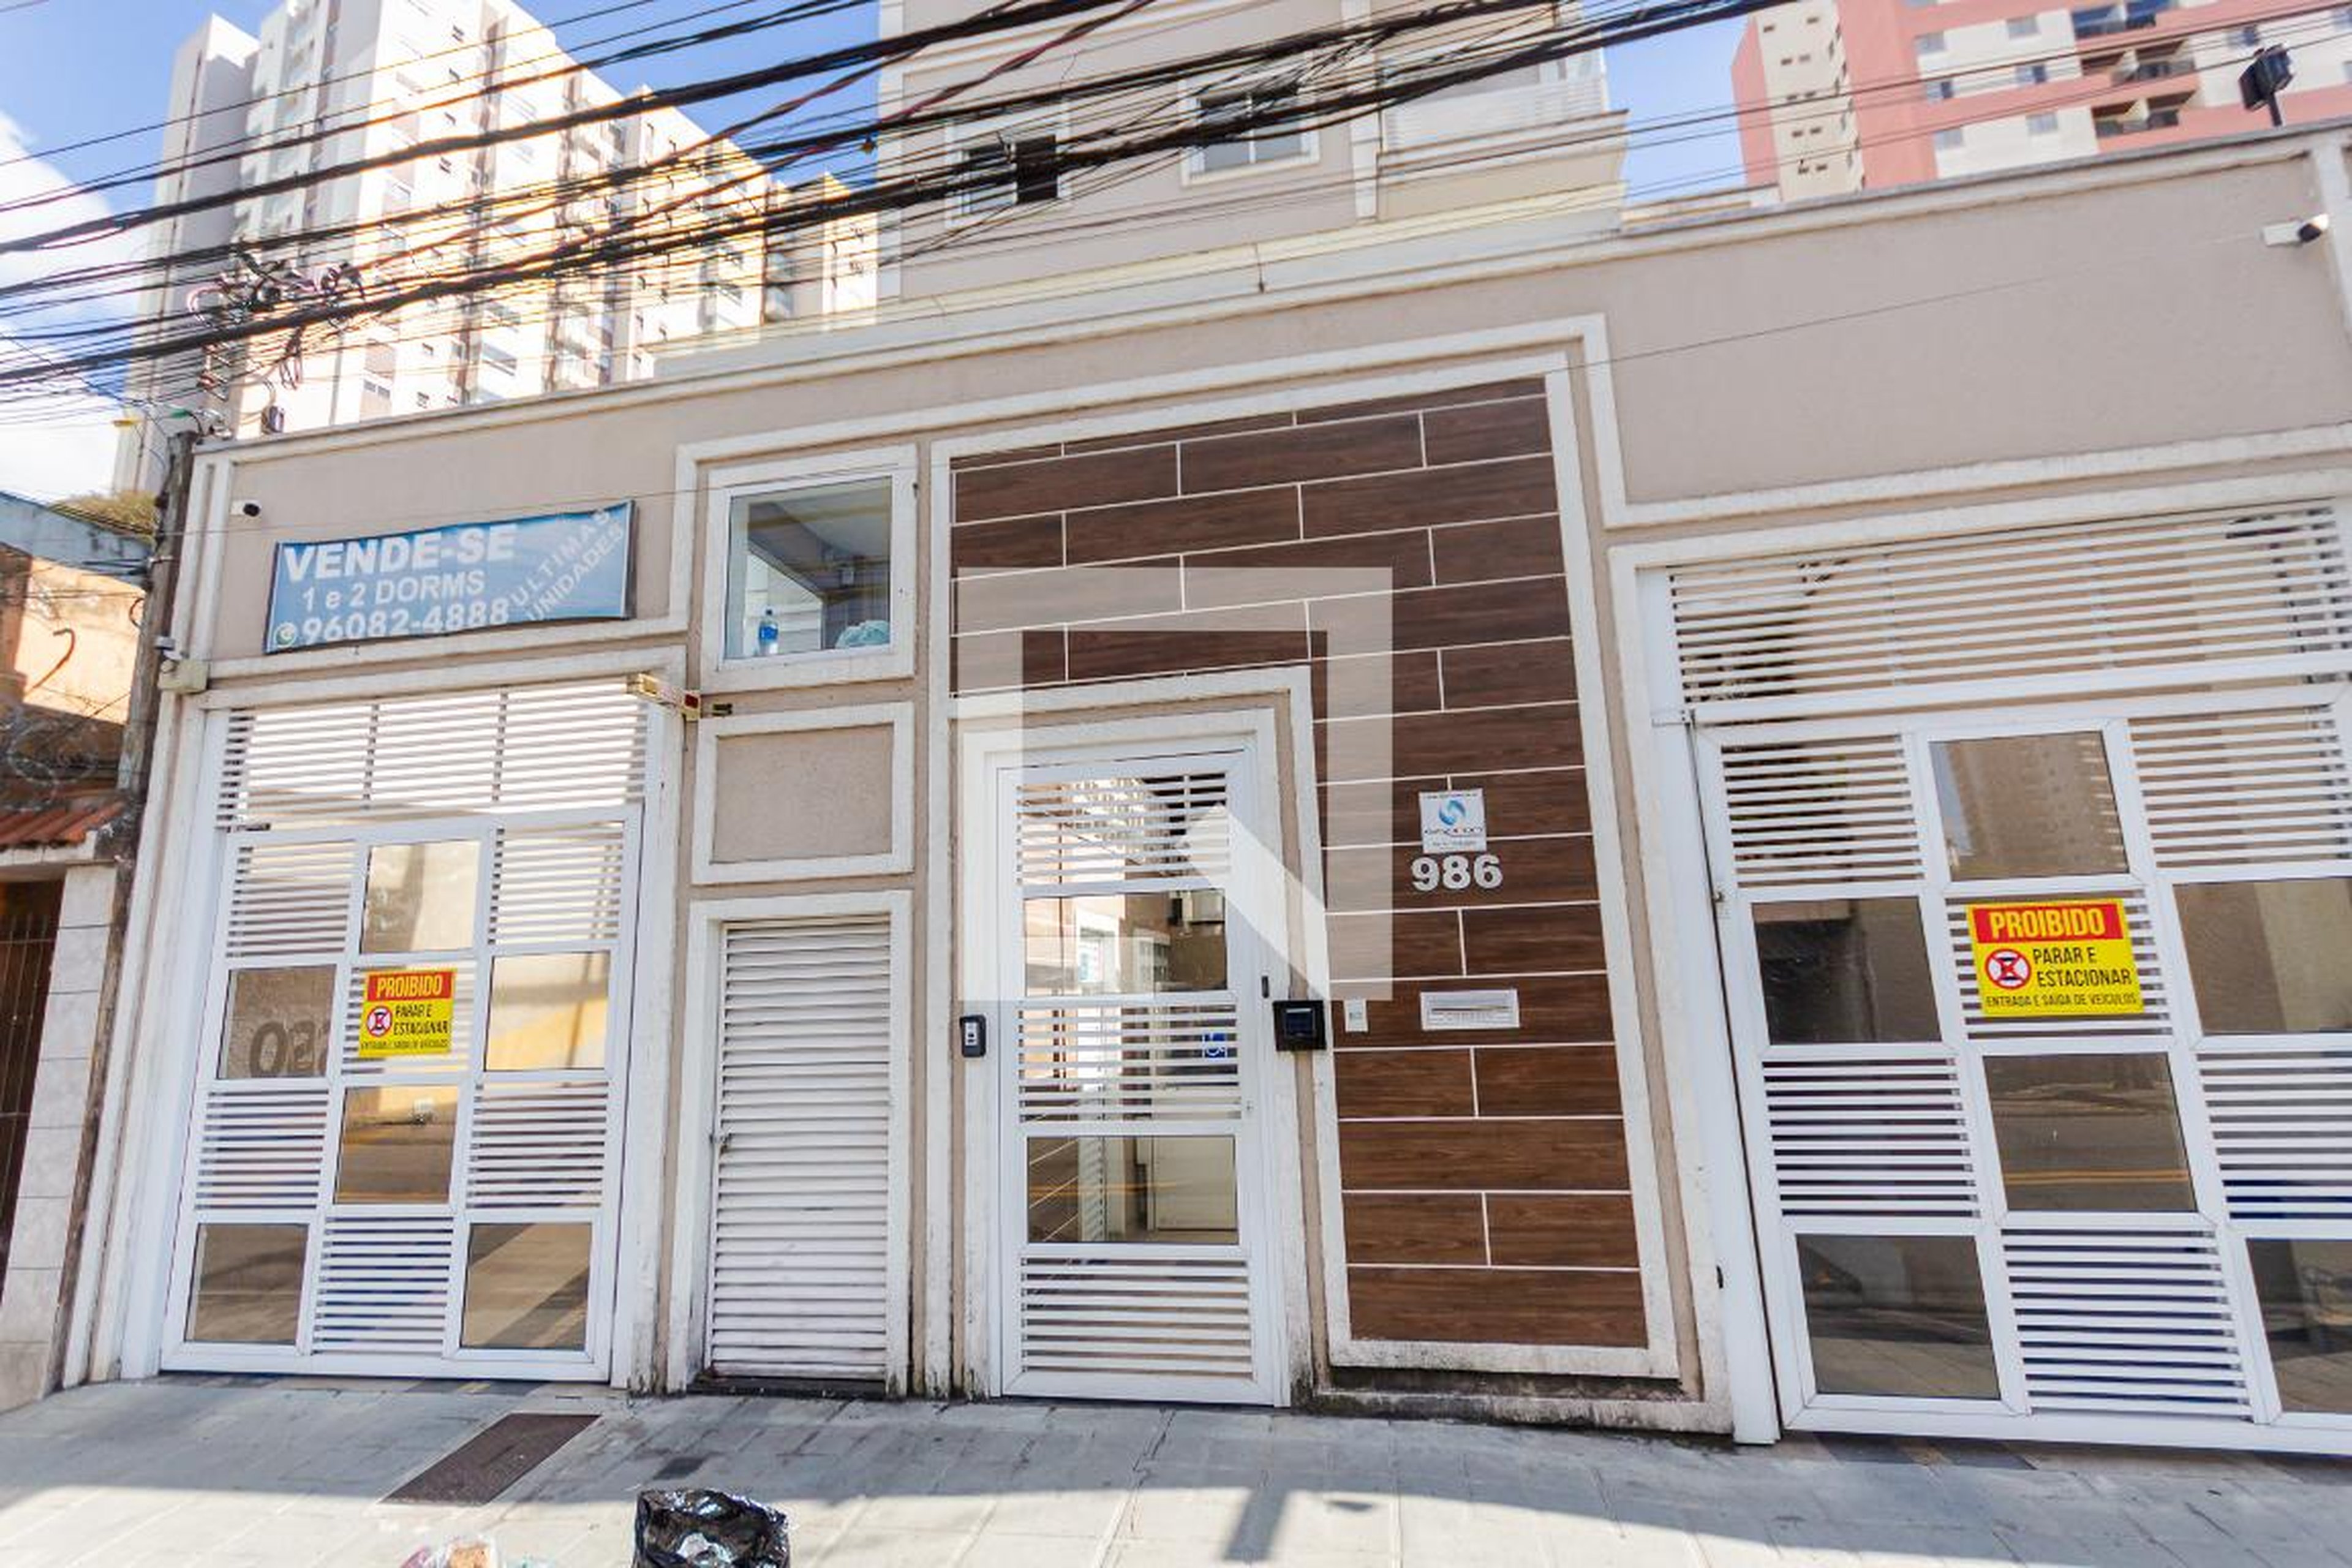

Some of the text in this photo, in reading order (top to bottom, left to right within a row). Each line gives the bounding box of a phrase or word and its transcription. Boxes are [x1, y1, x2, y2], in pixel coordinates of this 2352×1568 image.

[284, 524, 518, 582] VENDE-SE
[527, 522, 624, 620] UNIDADES
[302, 570, 485, 612] 1 e 2 DORMS
[301, 597, 510, 645] 96082-4888
[1411, 854, 1504, 891] 986
[1989, 908, 2106, 939] PROIBIDO
[2033, 947, 2097, 965] PARAR E
[376, 976, 443, 999] PROIBIDO
[2037, 969, 2132, 988] ESTACIONAR
[394, 1005, 424, 1017] PARAR
[1986, 995, 2032, 1006] ENTRADA
[394, 1021, 448, 1035] ESTACIONAR
